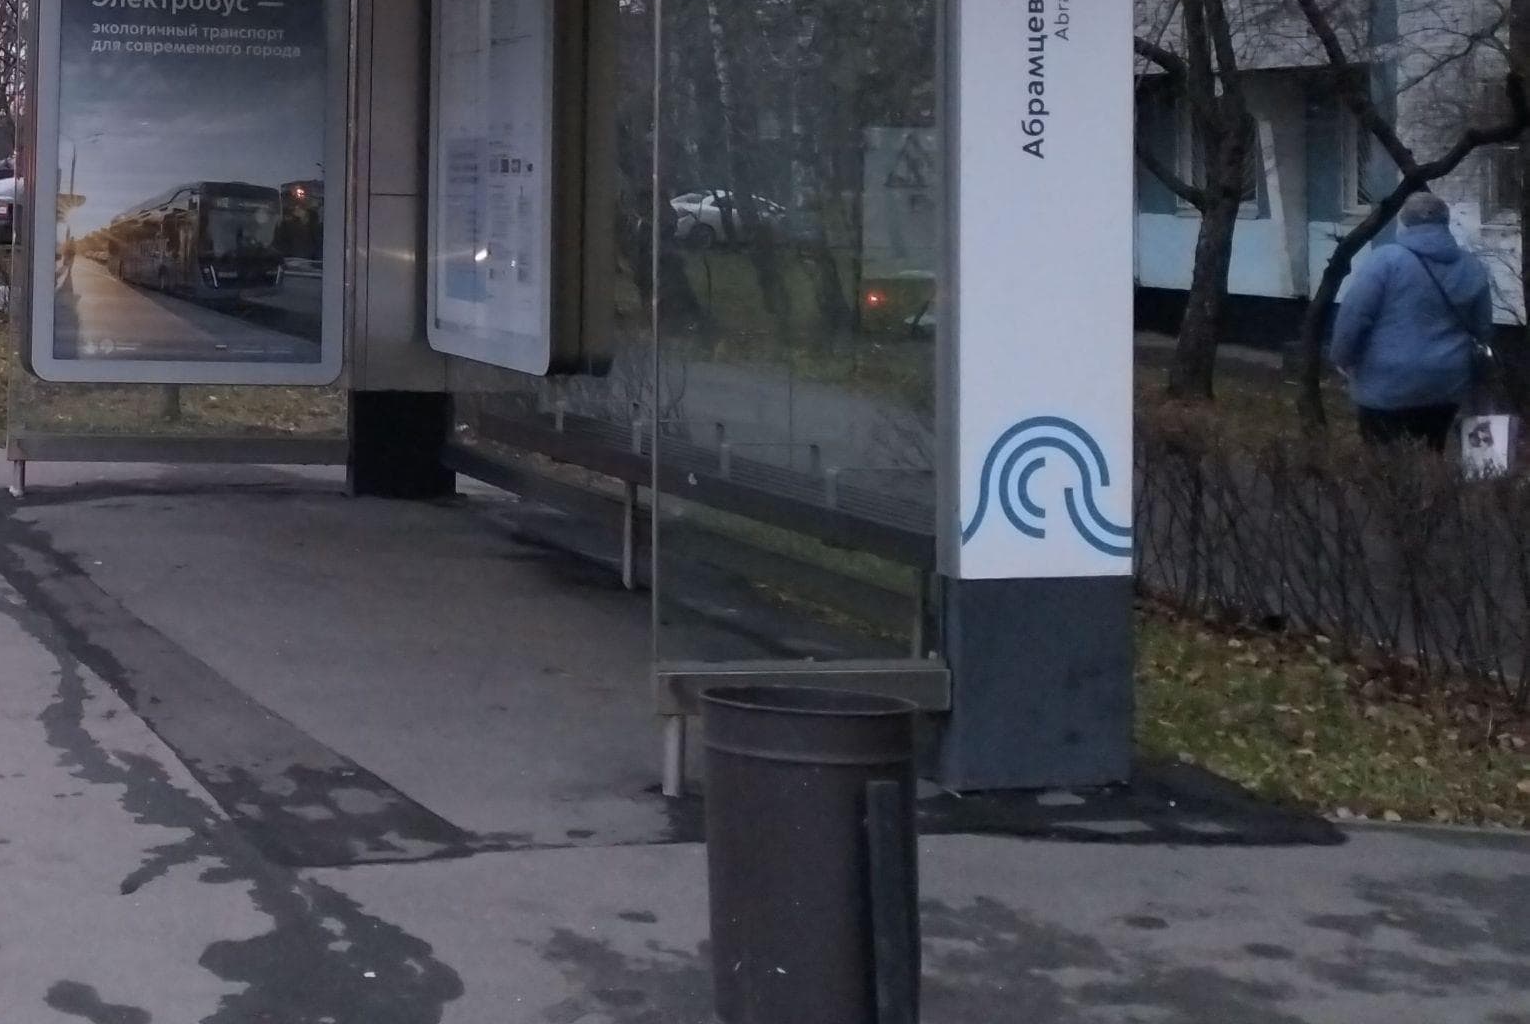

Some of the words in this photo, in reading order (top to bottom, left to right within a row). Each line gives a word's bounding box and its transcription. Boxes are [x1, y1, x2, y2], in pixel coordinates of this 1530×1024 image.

[92, 23, 198, 37] экологичный
[202, 26, 285, 41] транспорт
[91, 40, 120, 52] для
[125, 40, 241, 55] современного
[246, 45, 301, 58] города
